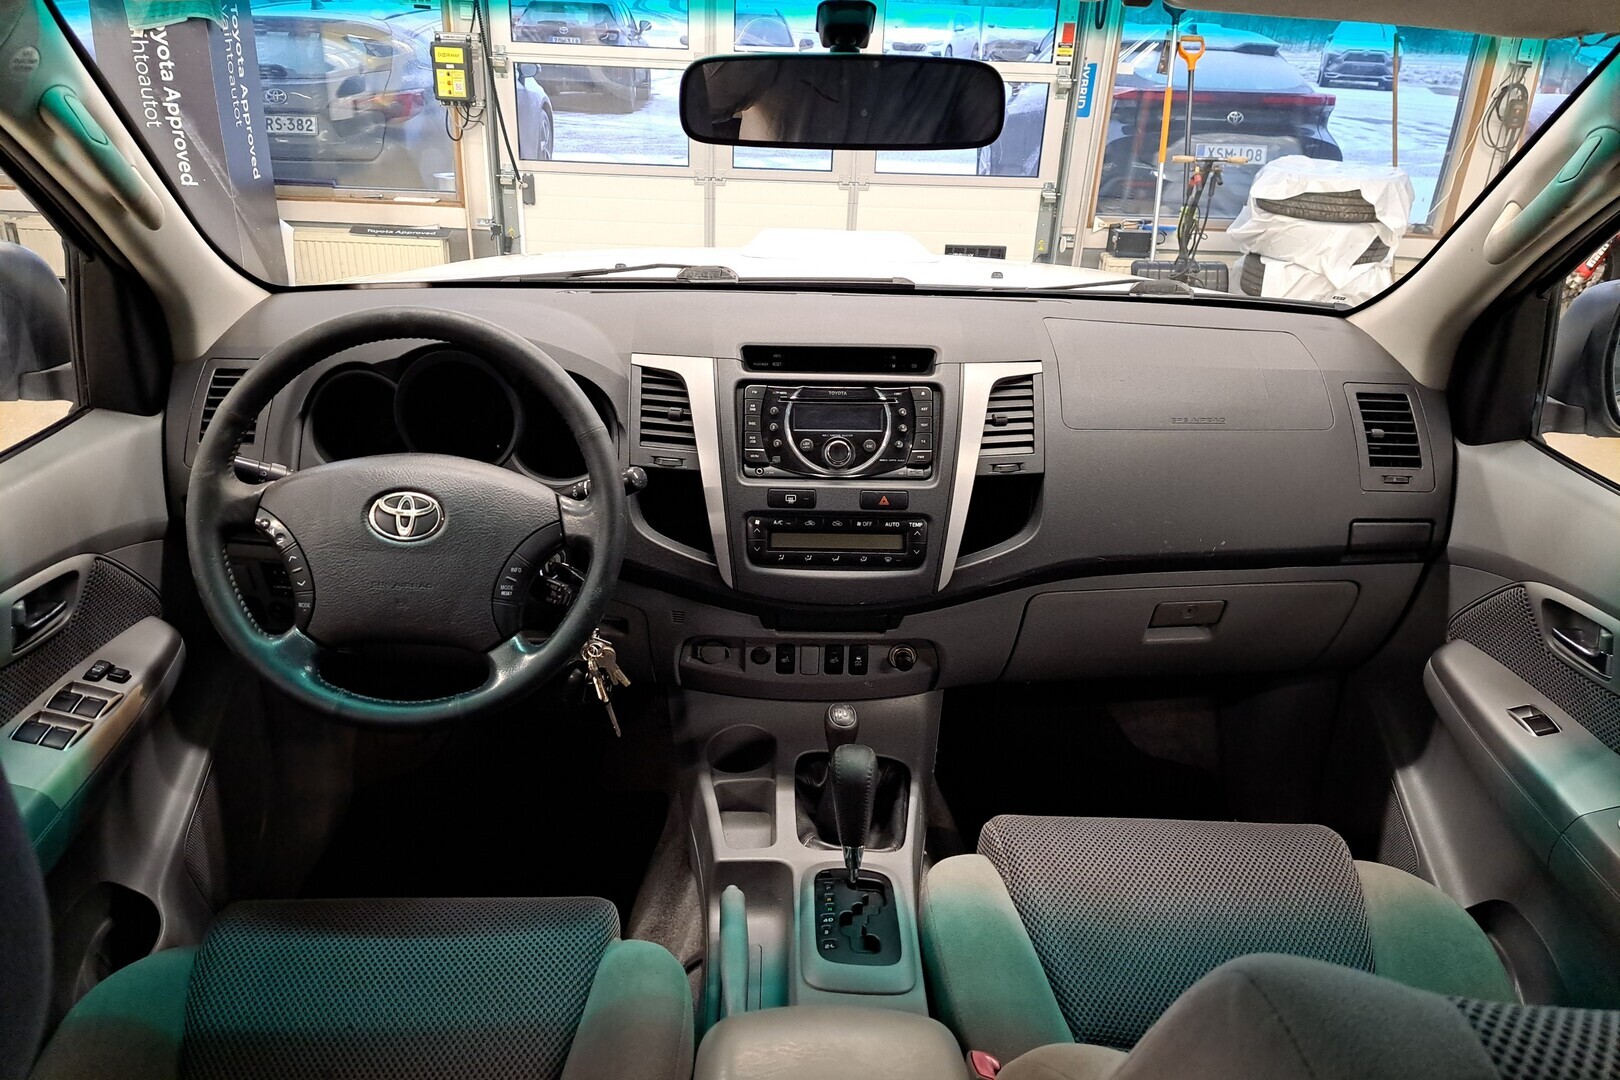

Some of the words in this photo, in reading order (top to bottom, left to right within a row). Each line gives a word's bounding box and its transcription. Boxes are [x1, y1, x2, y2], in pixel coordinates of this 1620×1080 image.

[130, 28, 162, 129] ihtoautot
[150, 26, 175, 82] yota
[163, 86, 199, 187] Approved
[230, 4, 245, 78] Toyota
[239, 84, 261, 179] Approved
[265, 117, 314, 132] RS-382
